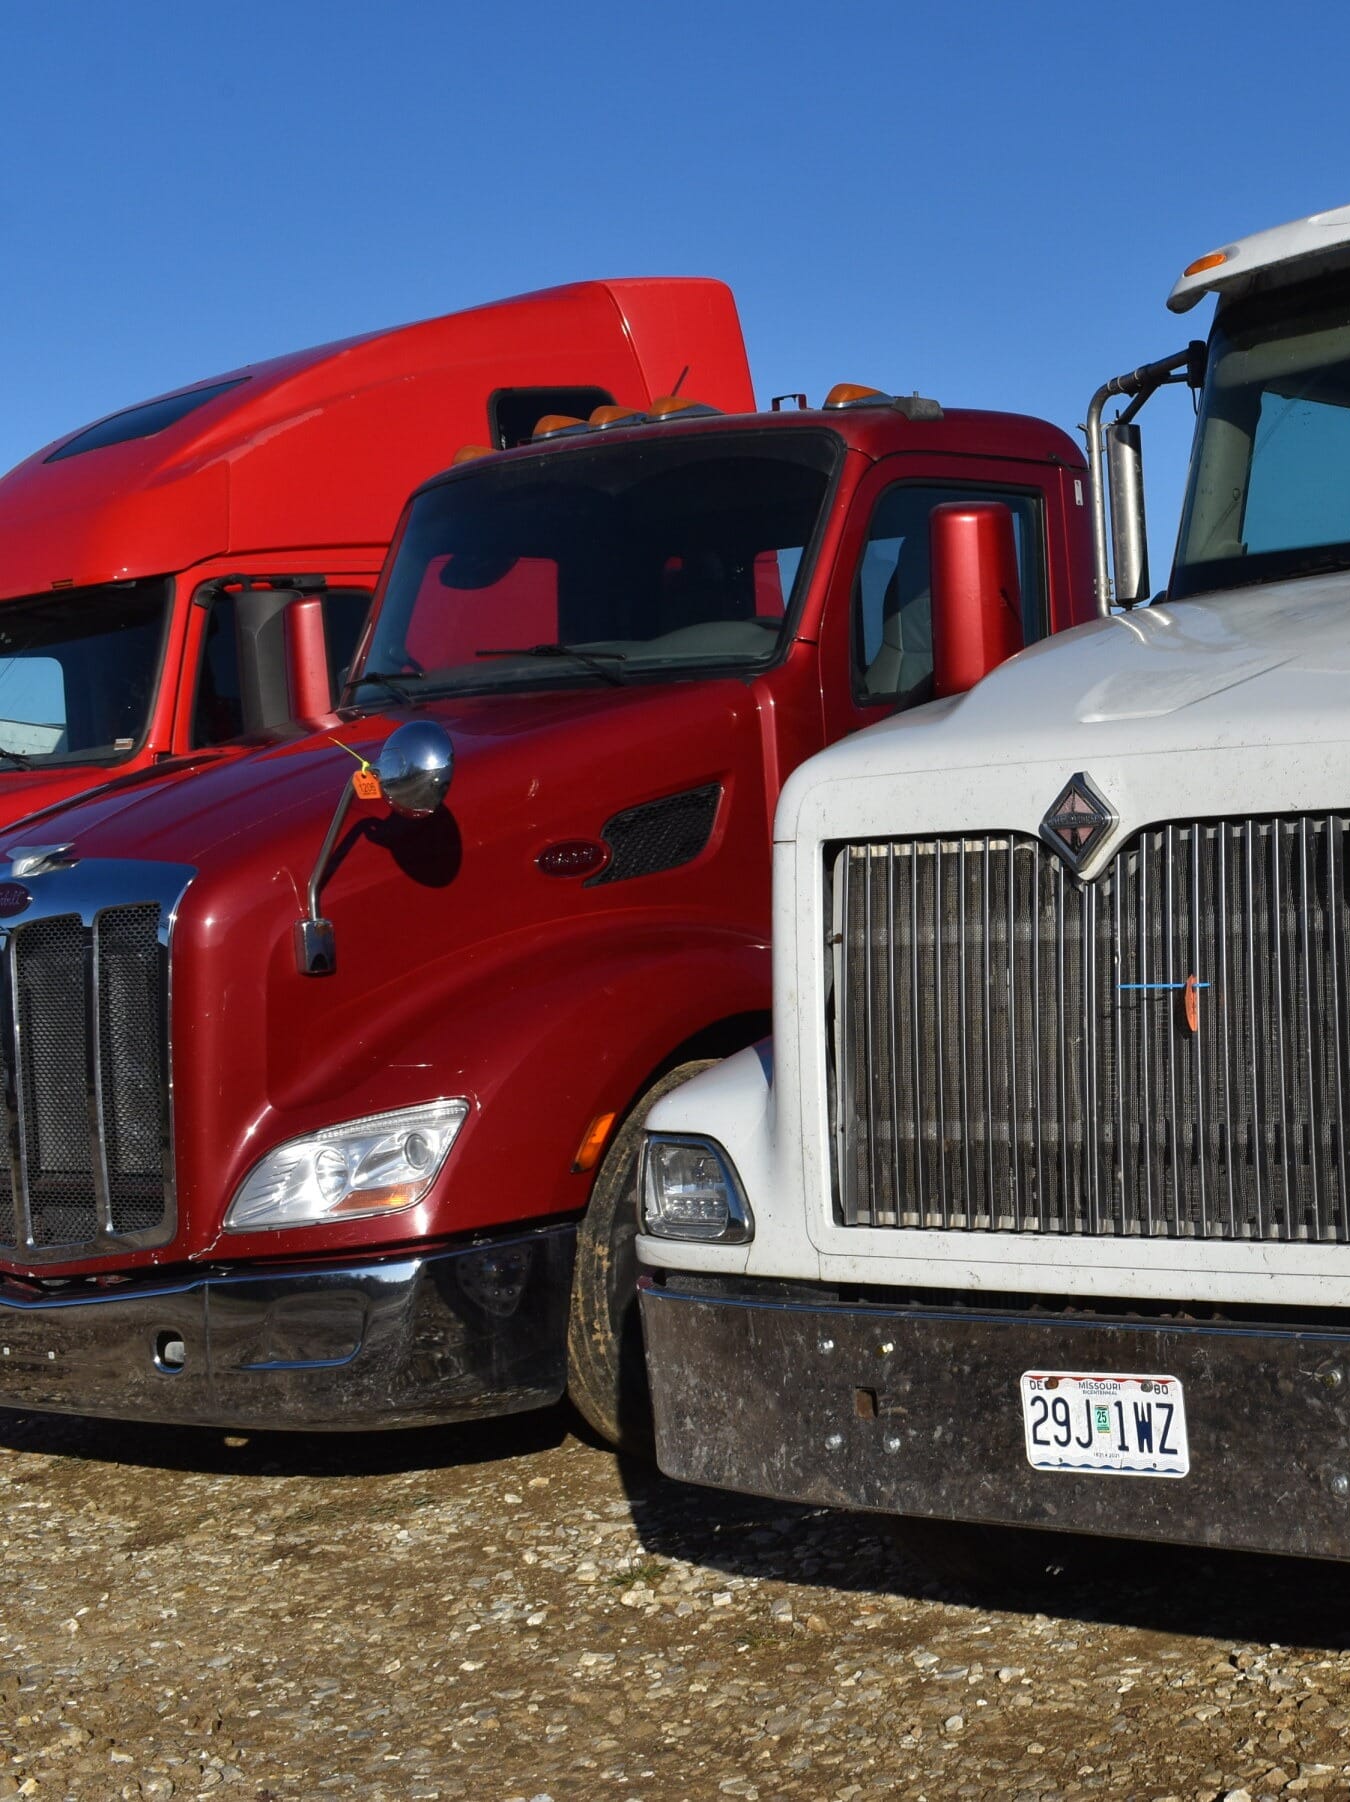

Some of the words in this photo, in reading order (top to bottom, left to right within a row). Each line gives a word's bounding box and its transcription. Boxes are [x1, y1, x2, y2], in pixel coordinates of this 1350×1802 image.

[1078, 1382, 1122, 1391] MISSOURI
[1097, 1411, 1108, 1424] 25
[1031, 1396, 1093, 1449] 29J
[1114, 1400, 1178, 1455] 1WZ
